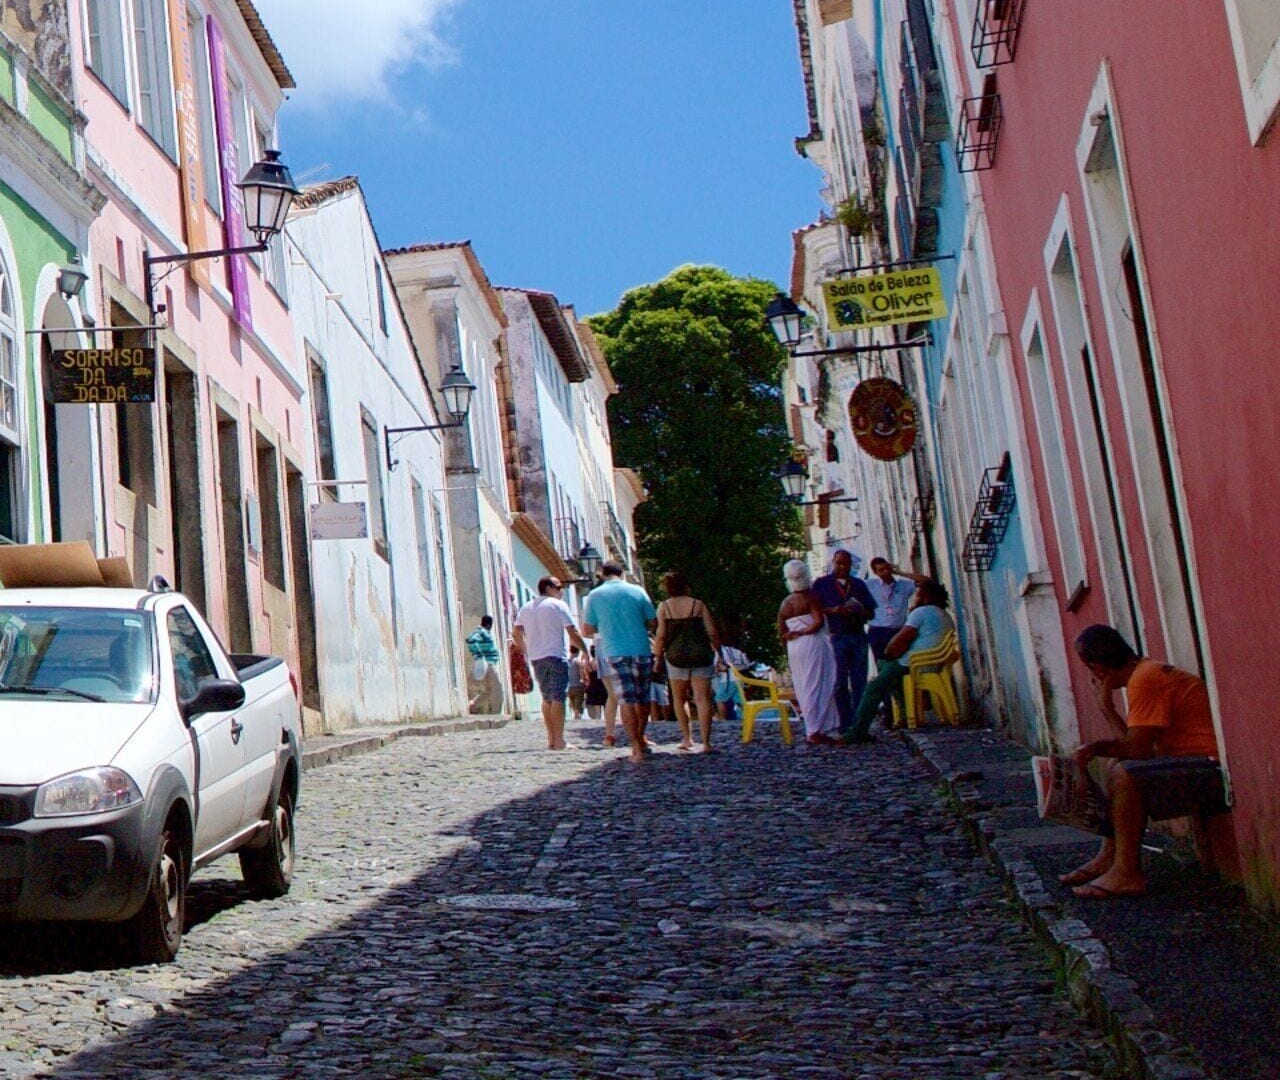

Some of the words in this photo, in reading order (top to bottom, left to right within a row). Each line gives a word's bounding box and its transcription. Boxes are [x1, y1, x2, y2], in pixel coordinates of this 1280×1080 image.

[830, 283, 865, 297] Salão
[869, 280, 884, 292] de
[886, 274, 930, 291] Beleza
[871, 291, 934, 312] Oliver
[61, 348, 144, 368] SORRISO
[73, 367, 106, 386] DA
